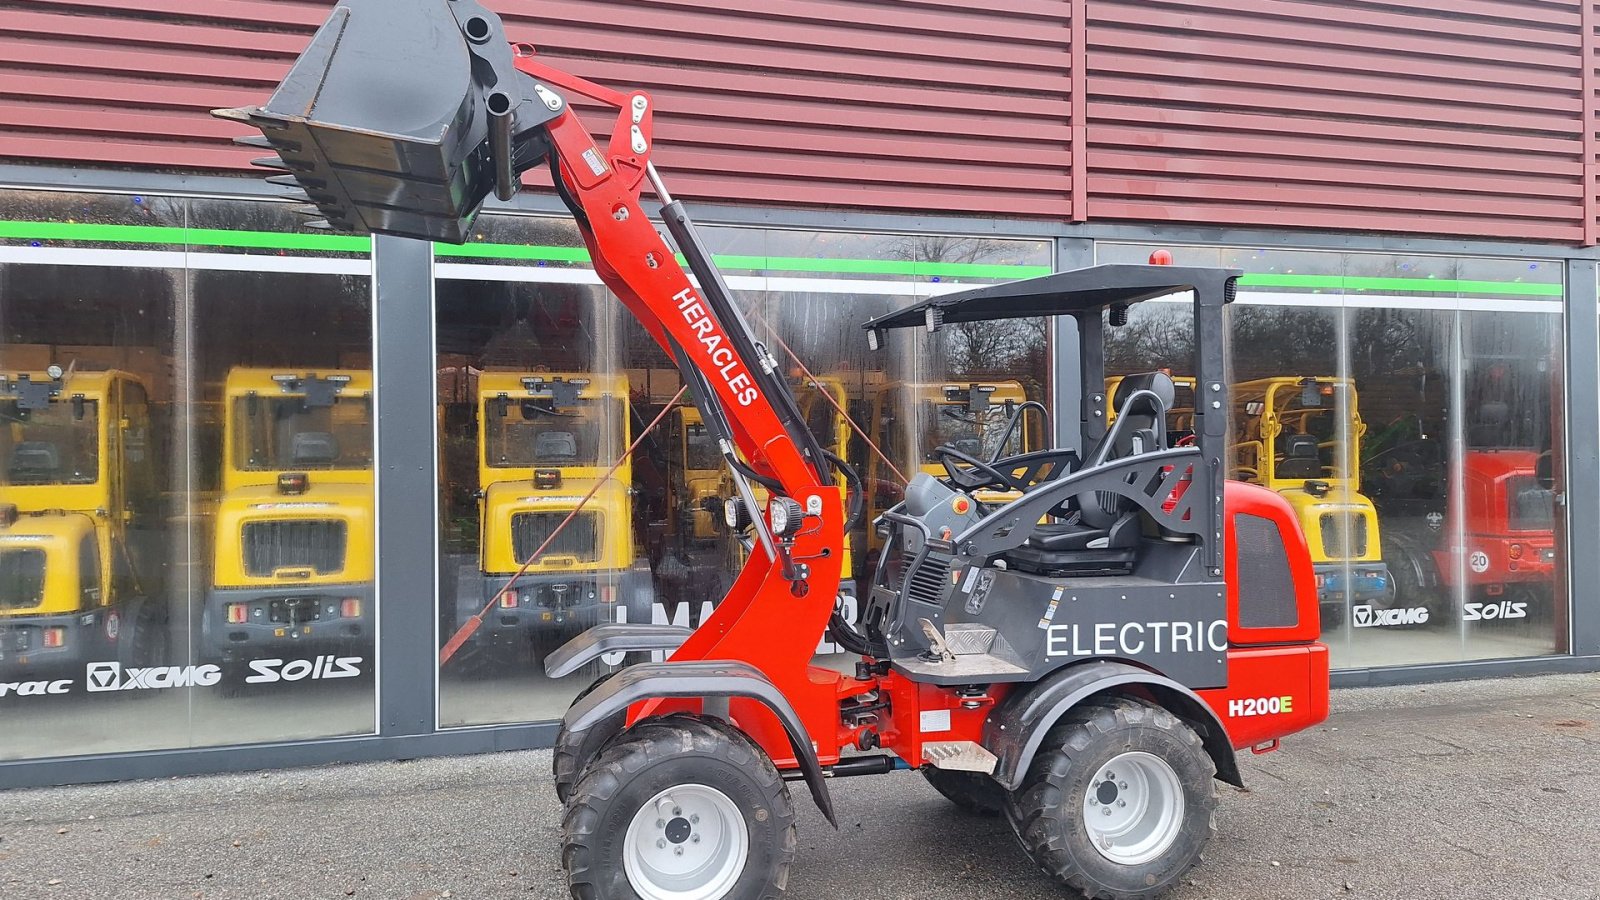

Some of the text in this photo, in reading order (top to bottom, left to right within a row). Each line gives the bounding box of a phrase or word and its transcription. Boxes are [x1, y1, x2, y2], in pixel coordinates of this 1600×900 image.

[672, 288, 758, 406] HERACLES
[1472, 555, 1486, 566] 20
[1373, 607, 1429, 626] XCMG
[1046, 620, 1228, 656] ELECTRIC
[119, 664, 222, 690] XCMG
[1229, 696, 1292, 717] H200E
